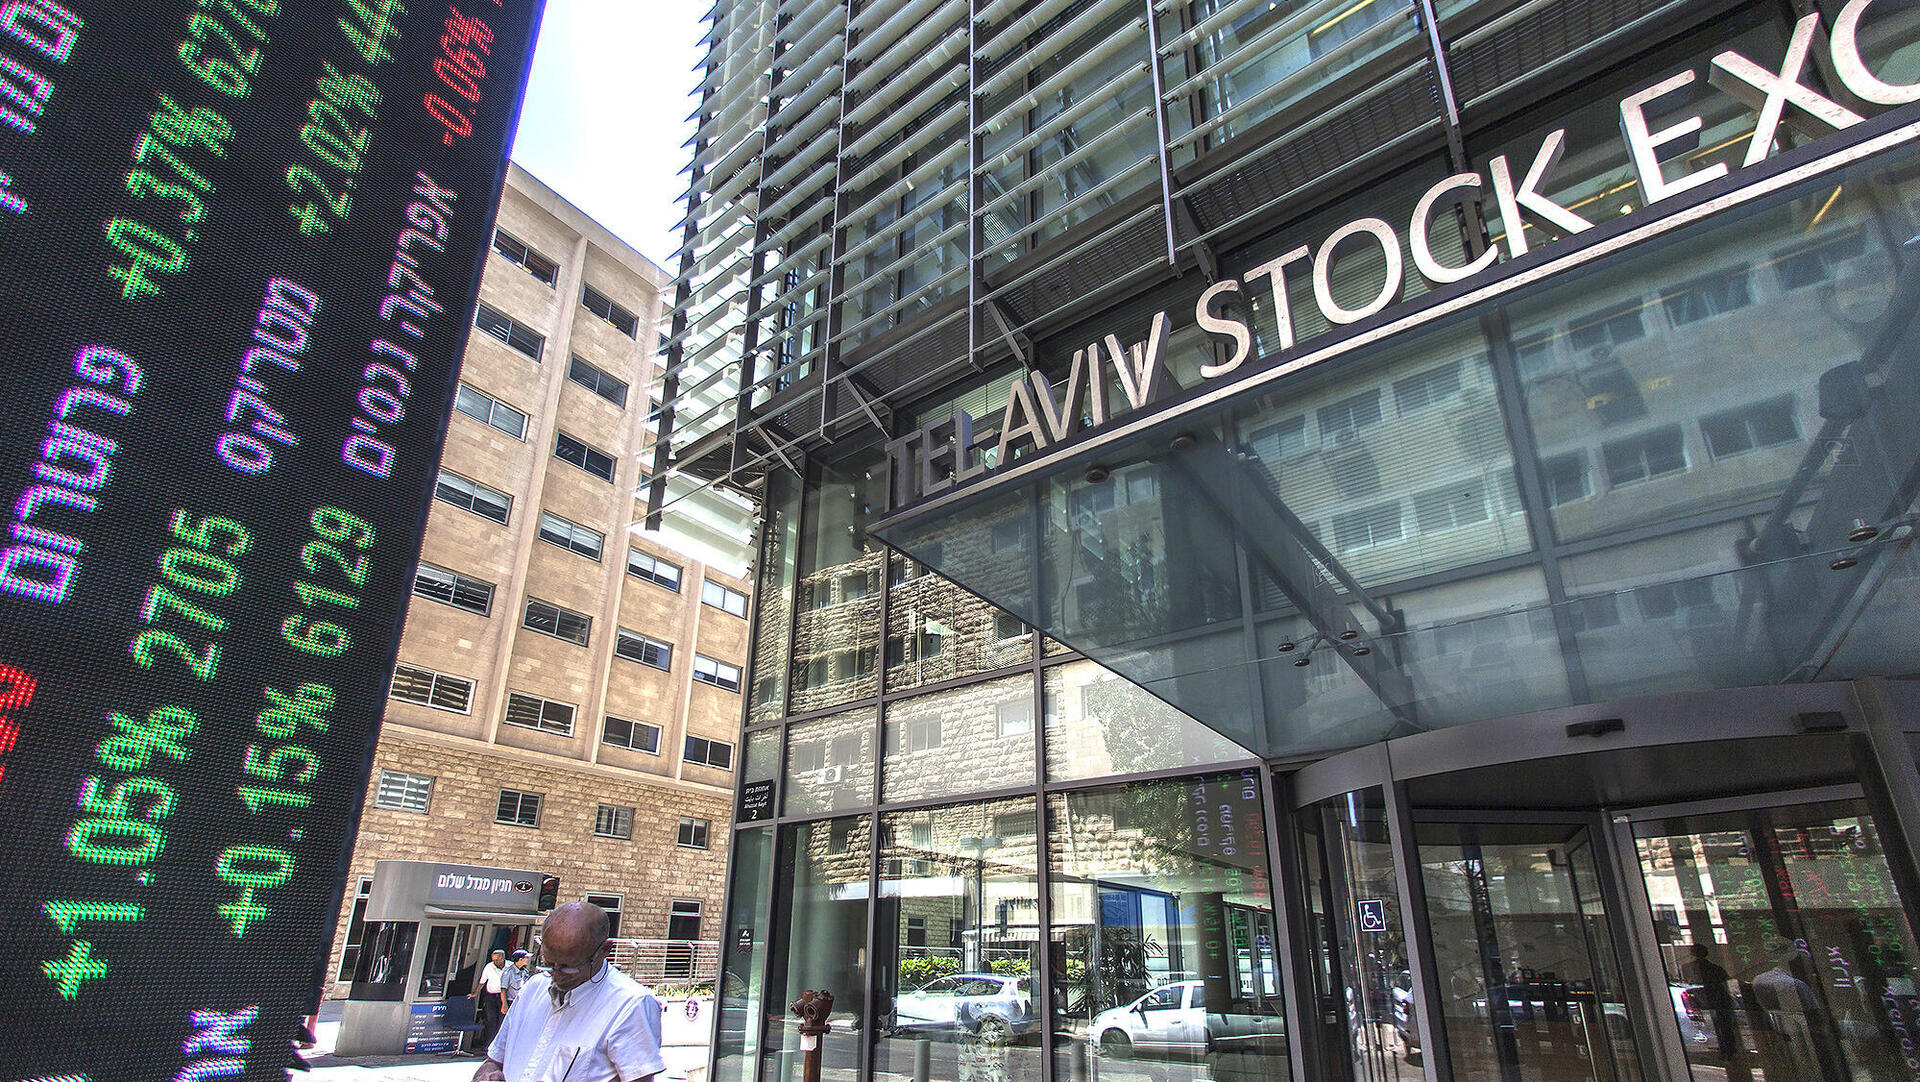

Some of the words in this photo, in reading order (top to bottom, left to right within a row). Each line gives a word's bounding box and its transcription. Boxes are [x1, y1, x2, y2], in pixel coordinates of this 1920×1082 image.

[288, 60, 382, 235] +2.02%
[423, 6, 495, 146] -0.06%
[104, 93, 236, 299] +0.37%
[378, 170, 457, 338] אפריקה
[1195, 128, 1594, 379] STOCK
[215, 277, 324, 475] מטריקס
[340, 337, 419, 480] נכסים
[0, 344, 147, 605] פרוטרום
[129, 508, 255, 681] 2705
[281, 505, 376, 658] 6129
[41, 705, 202, 1000] +1.05%
[216, 682, 336, 938] +0.15%
[437, 872, 466, 889] שלום
[466, 874, 491, 891] מגדל
[490, 879, 512, 894] חניון
[751, 809, 758, 820] 2
